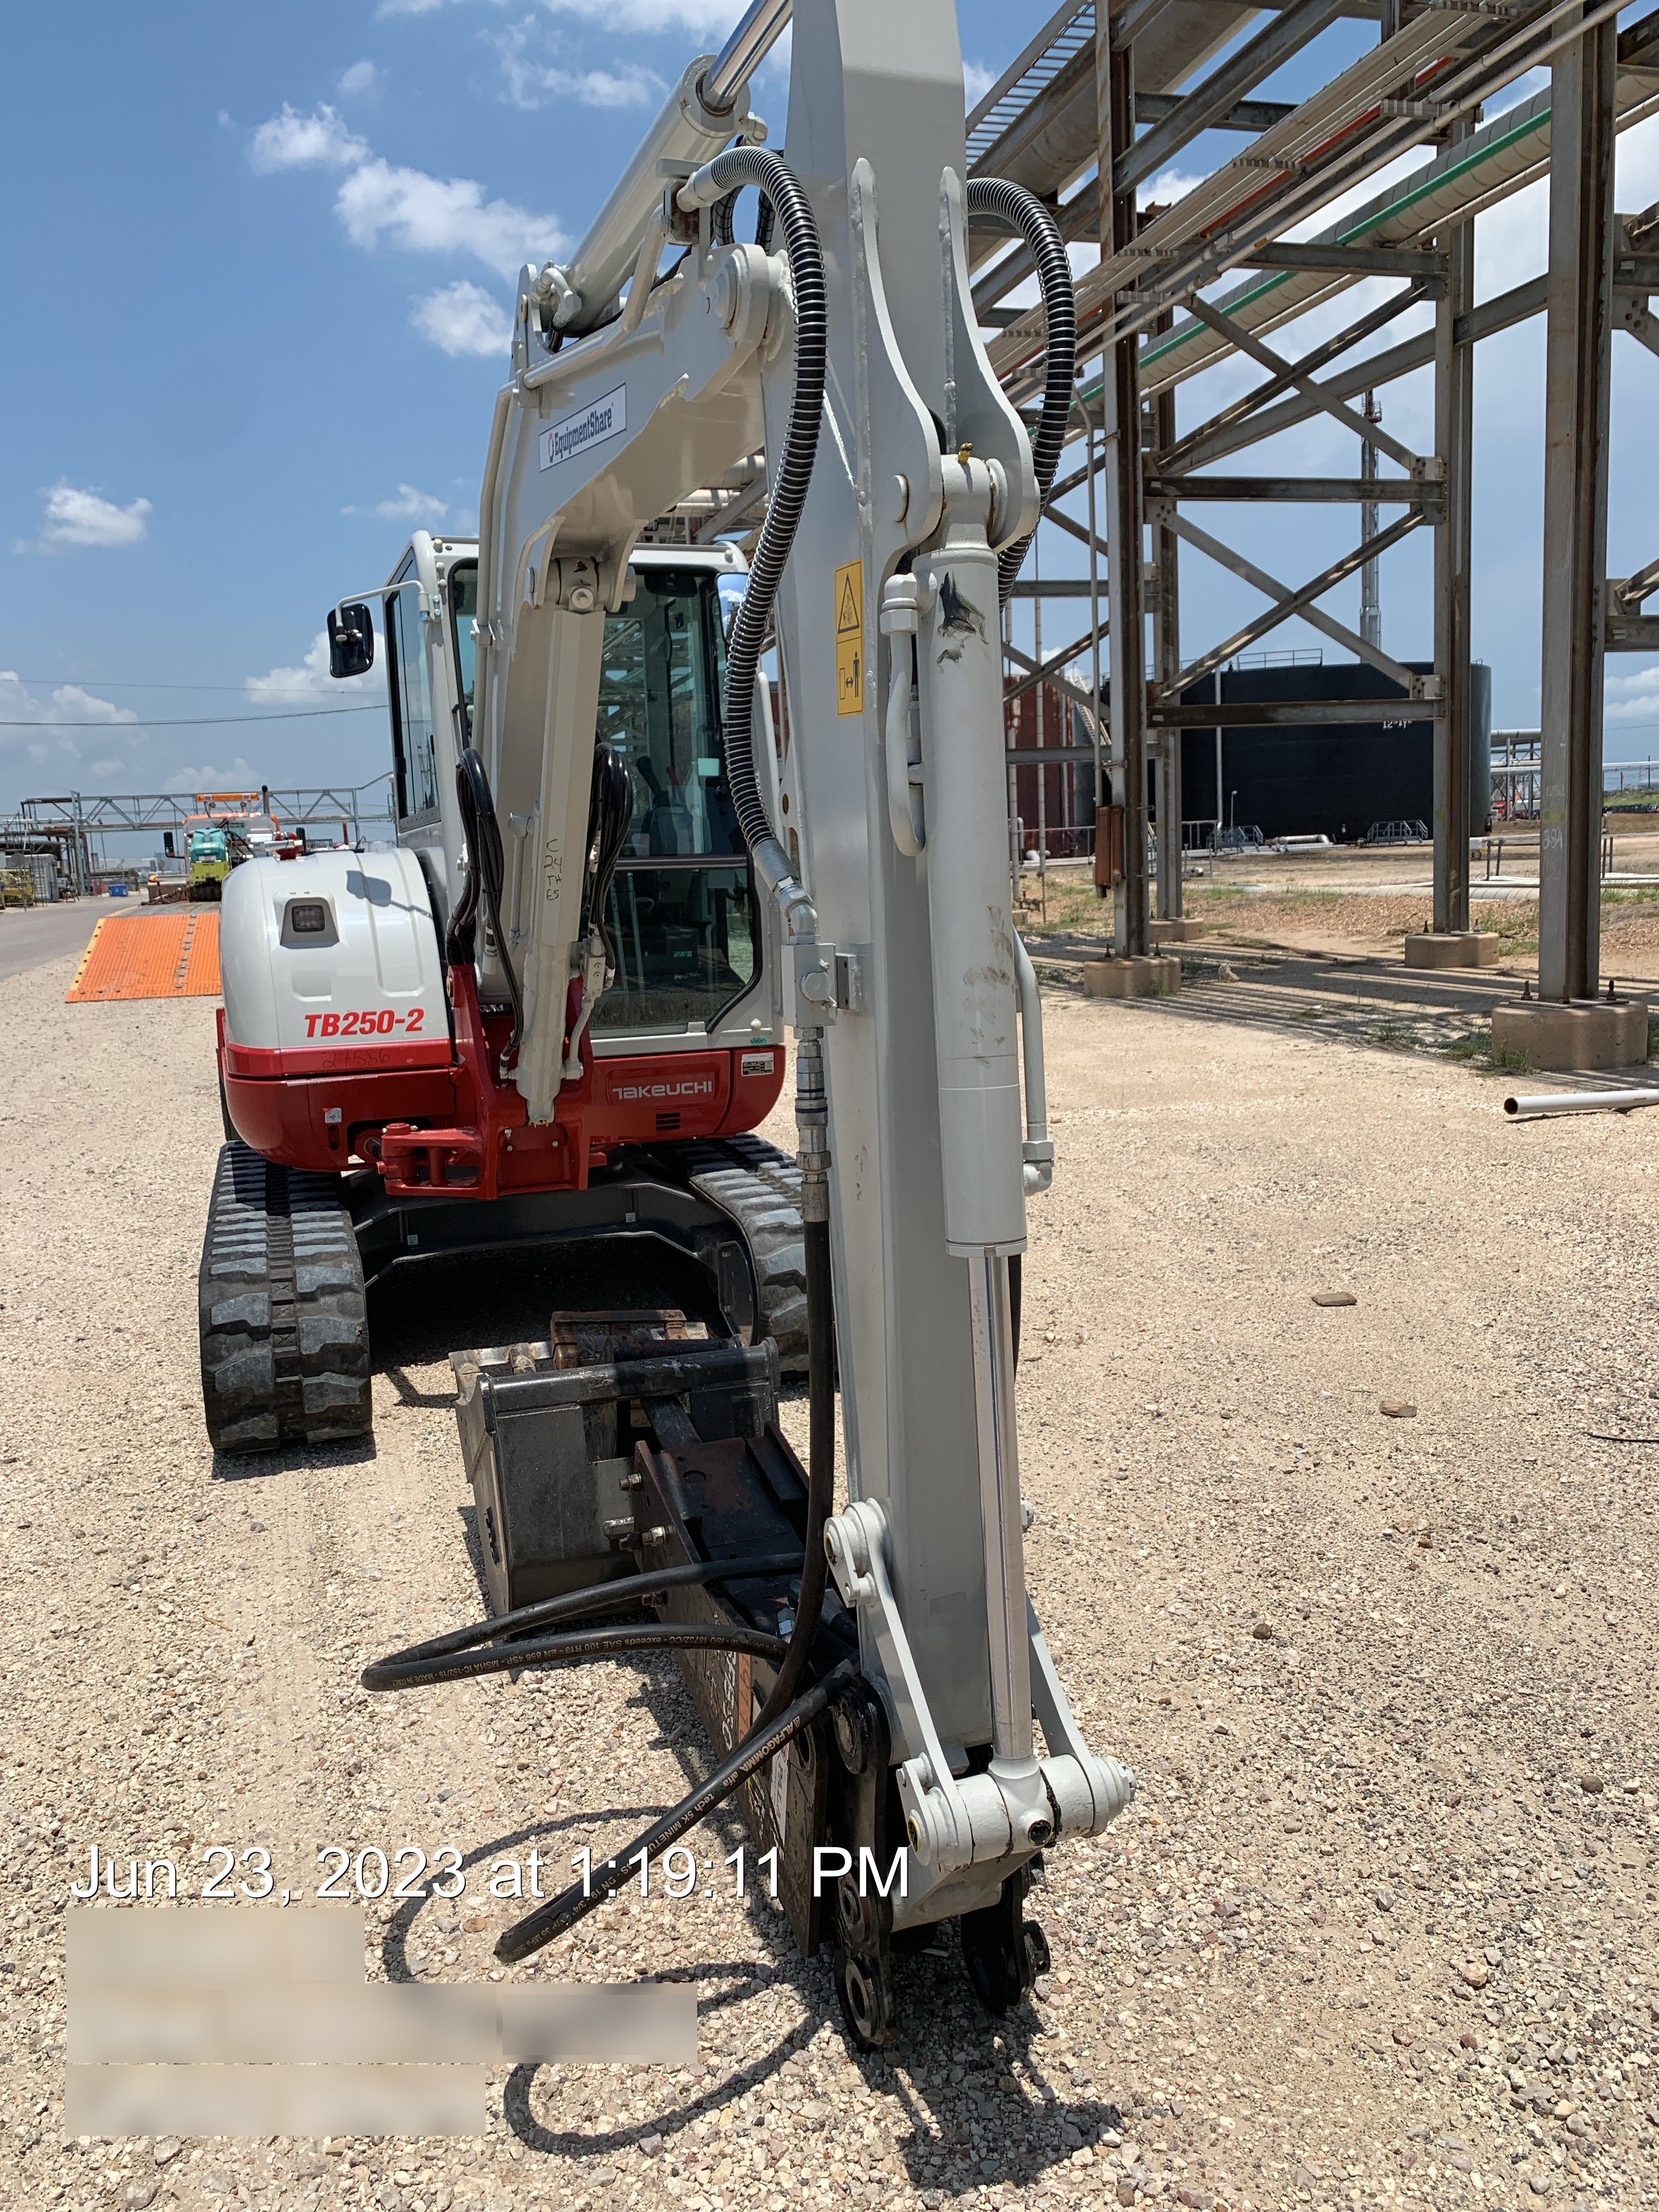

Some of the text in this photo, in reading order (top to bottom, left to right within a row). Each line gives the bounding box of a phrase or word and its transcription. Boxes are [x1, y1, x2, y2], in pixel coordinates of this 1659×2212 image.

[554, 408, 612, 459] EquipmentShare
[304, 1008, 424, 1037] TB250-2
[584, 1641, 599, 1651] 100
[603, 1639, 622, 1647] SAE
[544, 1649, 556, 1657] EN
[566, 1645, 582, 1654] R13
[507, 1656, 523, 1665] 4SP
[526, 1651, 541, 1661] 856
[473, 1659, 499, 1671] MSHA
[439, 1665, 472, 1678] IC-152/16
[415, 1673, 434, 1683] MADE
[740, 1724, 793, 1772] ALFAGOMMA
[681, 1810, 694, 1824] 5K
[647, 1822, 682, 1855] MINETU
[602, 1876, 616, 1891] DN
[590, 1888, 602, 1899] 19
[526, 1933, 542, 1947] MPa
